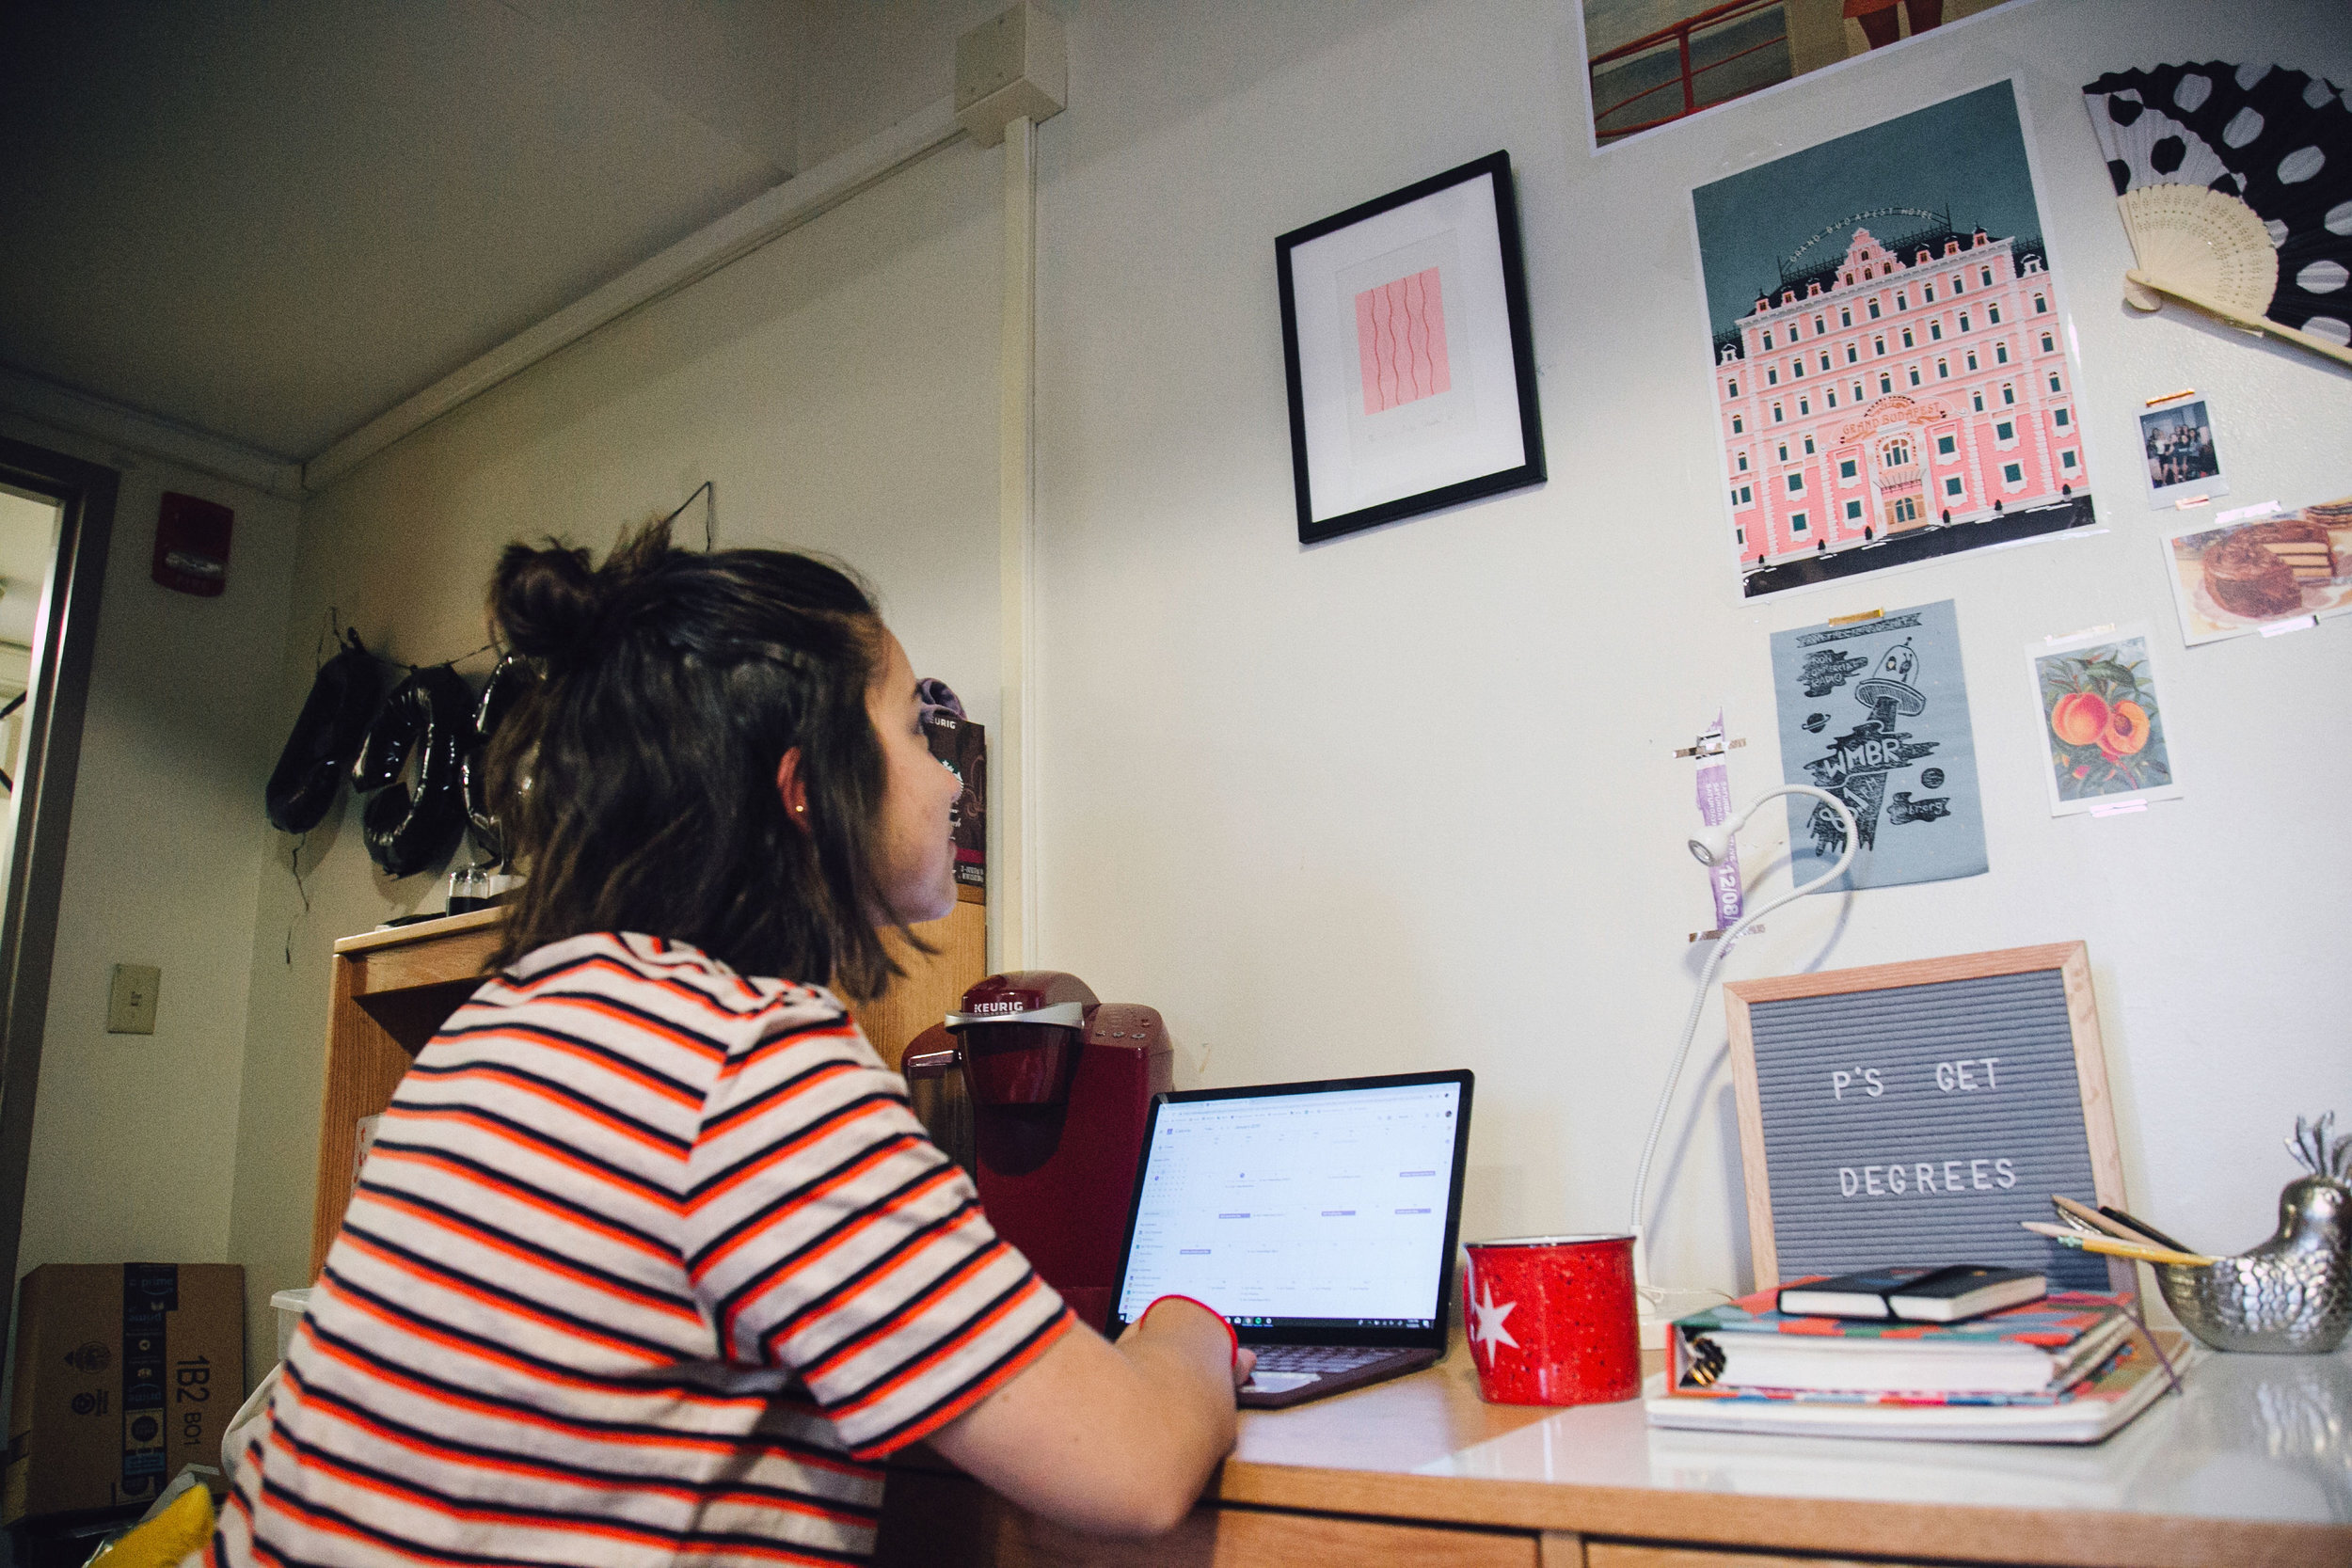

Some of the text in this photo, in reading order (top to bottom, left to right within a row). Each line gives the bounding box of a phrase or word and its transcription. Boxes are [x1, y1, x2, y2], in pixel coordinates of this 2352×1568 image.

[1843, 419, 1880, 435] GRAND
[1824, 738, 1900, 778] WMBR
[974, 1001, 1024, 1013] KEURIG
[1832, 1056, 2000, 1101] P'S GET
[1838, 1157, 2017, 1198] DEGREES
[177, 1354, 211, 1404] 1B2
